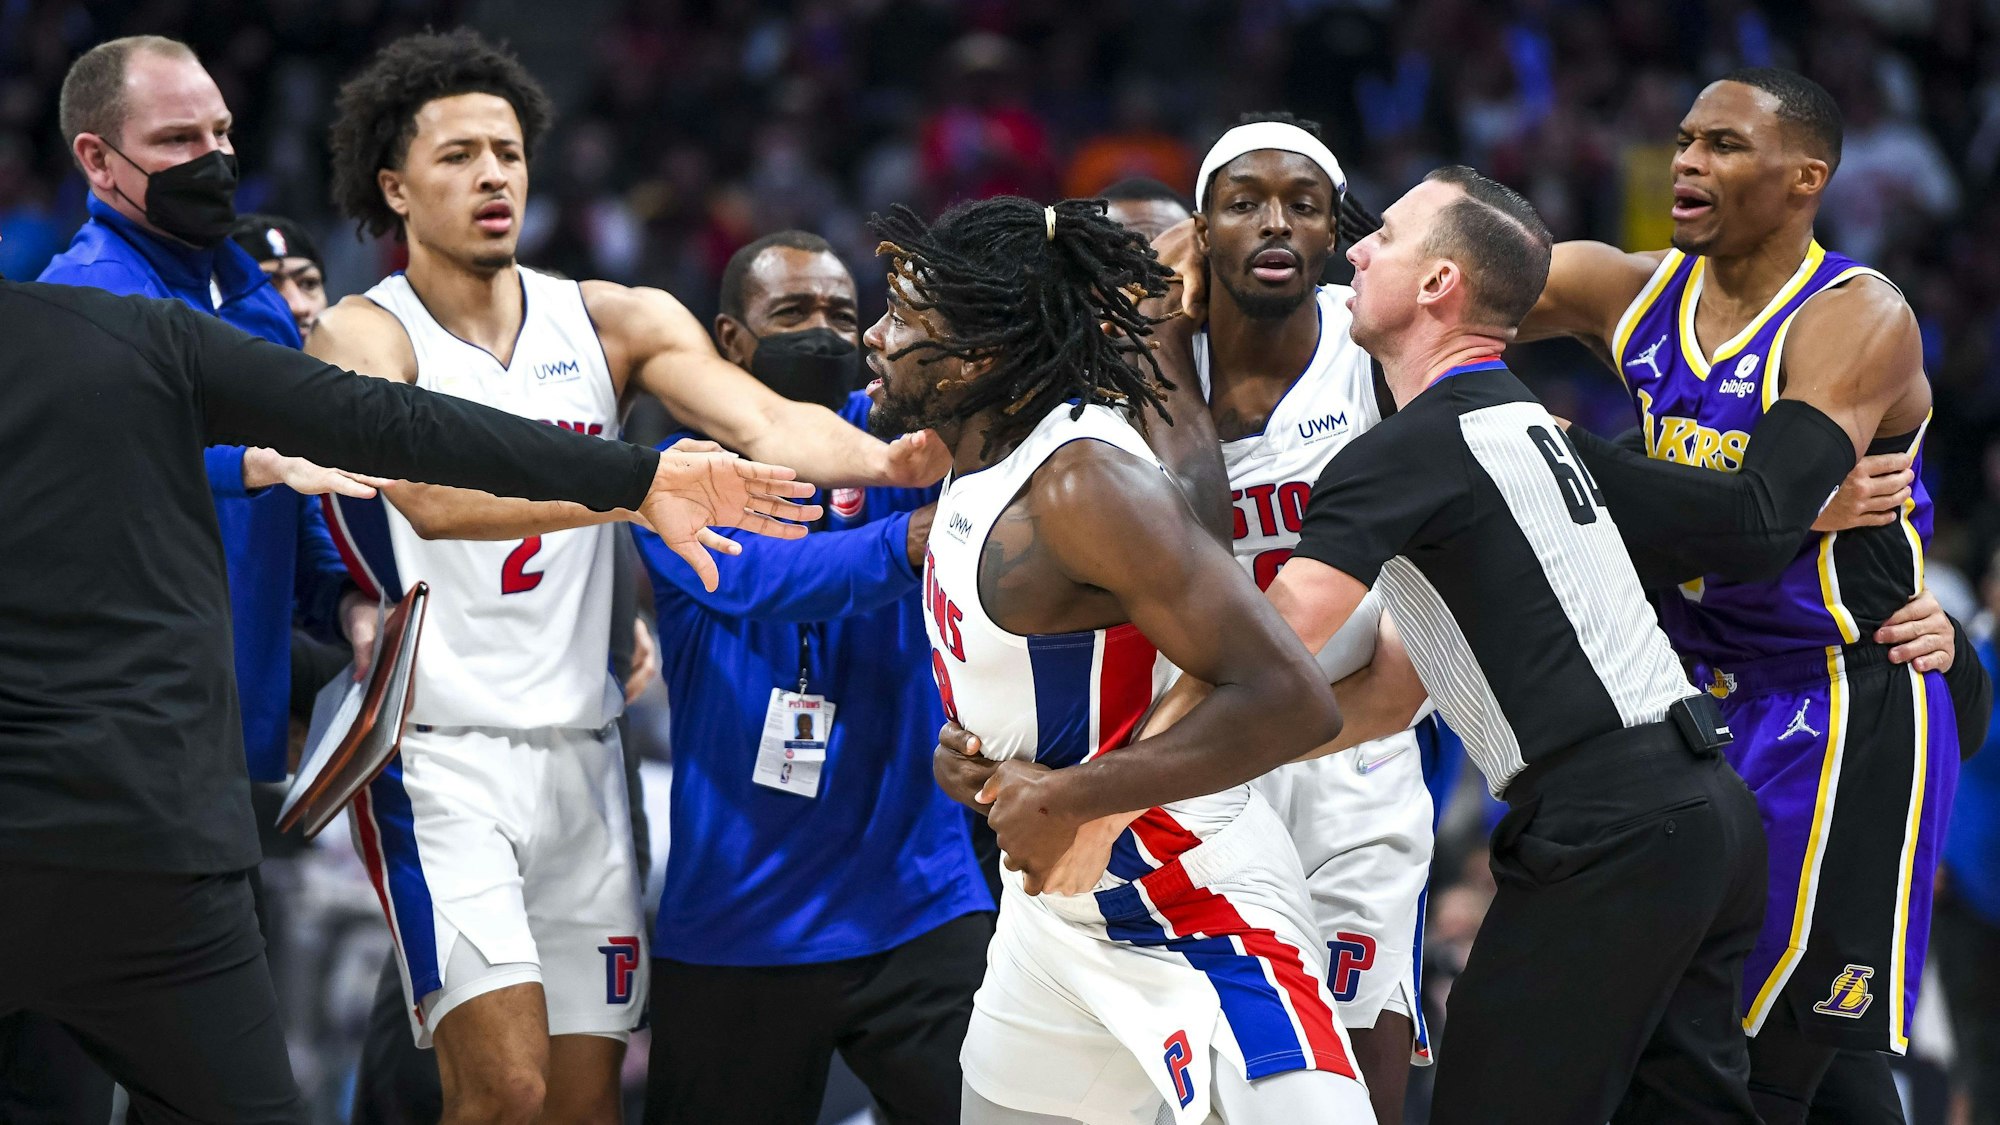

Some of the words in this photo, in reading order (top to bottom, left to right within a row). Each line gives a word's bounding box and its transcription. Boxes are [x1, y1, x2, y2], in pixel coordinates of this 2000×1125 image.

[533, 360, 580, 380] UWM
[1719, 379, 1755, 398] bibigo
[1298, 410, 1348, 439] UWM
[949, 510, 973, 539] UWM
[501, 534, 545, 595] 2
